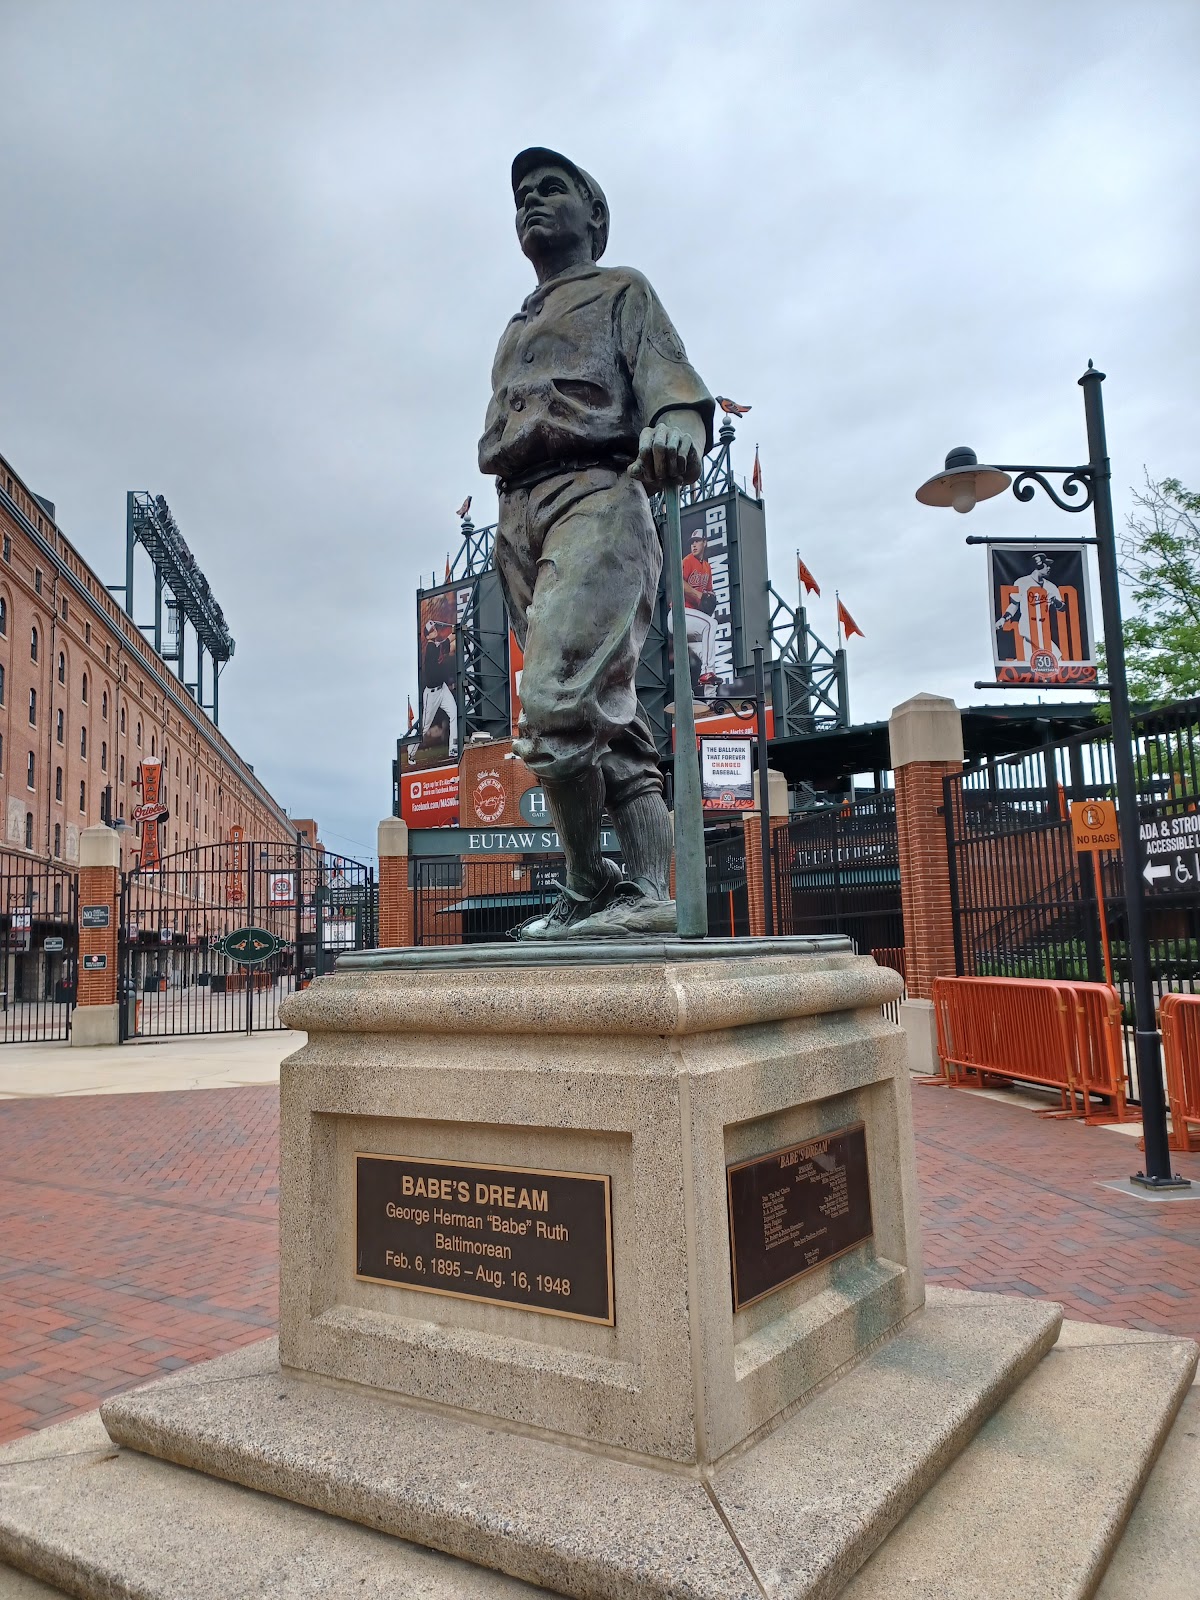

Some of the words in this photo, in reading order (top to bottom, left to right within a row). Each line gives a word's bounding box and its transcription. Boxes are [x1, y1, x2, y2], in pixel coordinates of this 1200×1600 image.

[706, 504, 727, 547] GET
[708, 553, 731, 619] MORE
[1000, 585, 1083, 661] 500
[715, 626, 734, 684] GAME
[1036, 656, 1051, 667] 30
[146, 767, 156, 800] TEAM
[134, 804, 167, 821] Orioles
[528, 793, 548, 812] H
[468, 833, 536, 849] EUTAW
[541, 832, 611, 848] STT
[1077, 835, 1090, 844] NO
[1092, 834, 1116, 843] BAGS
[1140, 823, 1159, 840] ADA
[1160, 821, 1170, 837] &
[1146, 835, 1195, 855] ACCESSIBLE
[276, 883, 287, 891] 30
[83, 910, 92, 919] NO
[402, 1175, 470, 1203] BABE'S
[475, 1182, 549, 1212] DREAM
[386, 1202, 430, 1225] George
[433, 1207, 483, 1229] Herman
[536, 1221, 569, 1241] Ruth
[435, 1232, 512, 1259] Baltimorean
[385, 1250, 411, 1269] Feb.
[415, 1255, 426, 1274] 6,
[431, 1257, 461, 1277] 1895
[475, 1265, 506, 1288] Aug.
[511, 1270, 531, 1292] 16,
[536, 1275, 571, 1296] 1948
